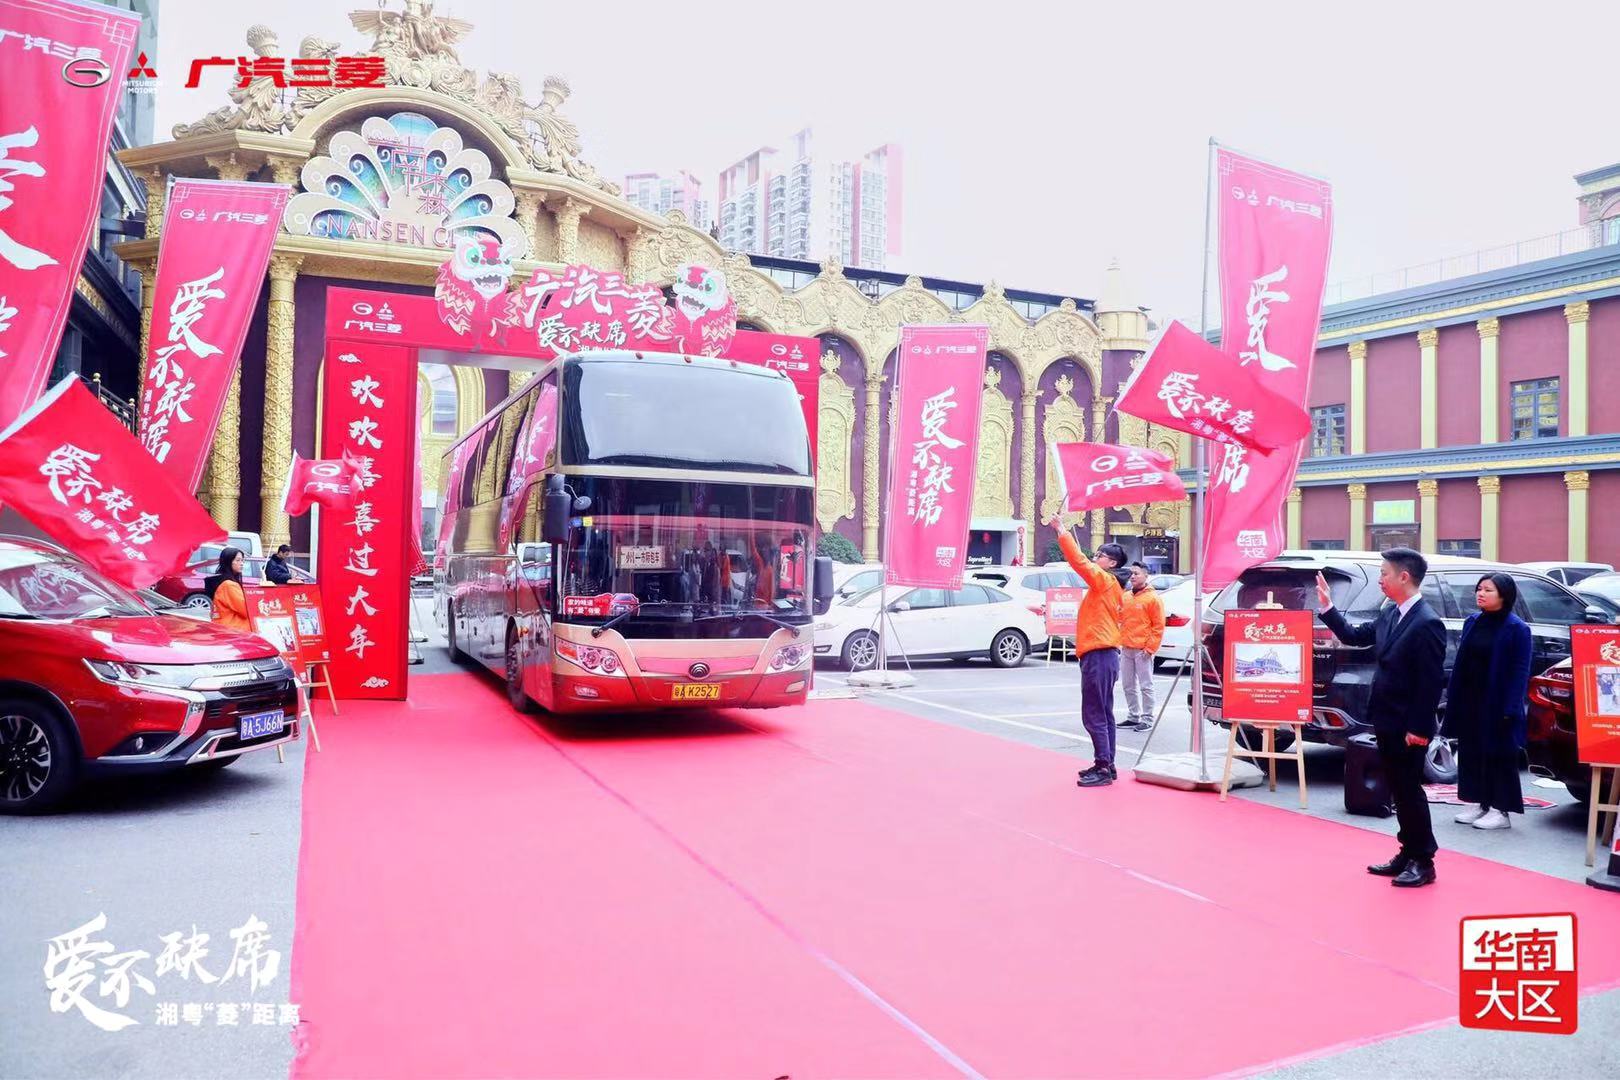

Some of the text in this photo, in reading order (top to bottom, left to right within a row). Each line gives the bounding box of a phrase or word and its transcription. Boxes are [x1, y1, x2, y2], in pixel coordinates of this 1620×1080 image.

[326, 213, 426, 247] NANSEN
[523, 268, 673, 342] 广汽三菱
[911, 386, 967, 527] 爱不缺席
[343, 374, 385, 660] 欢欢喜喜过大年
